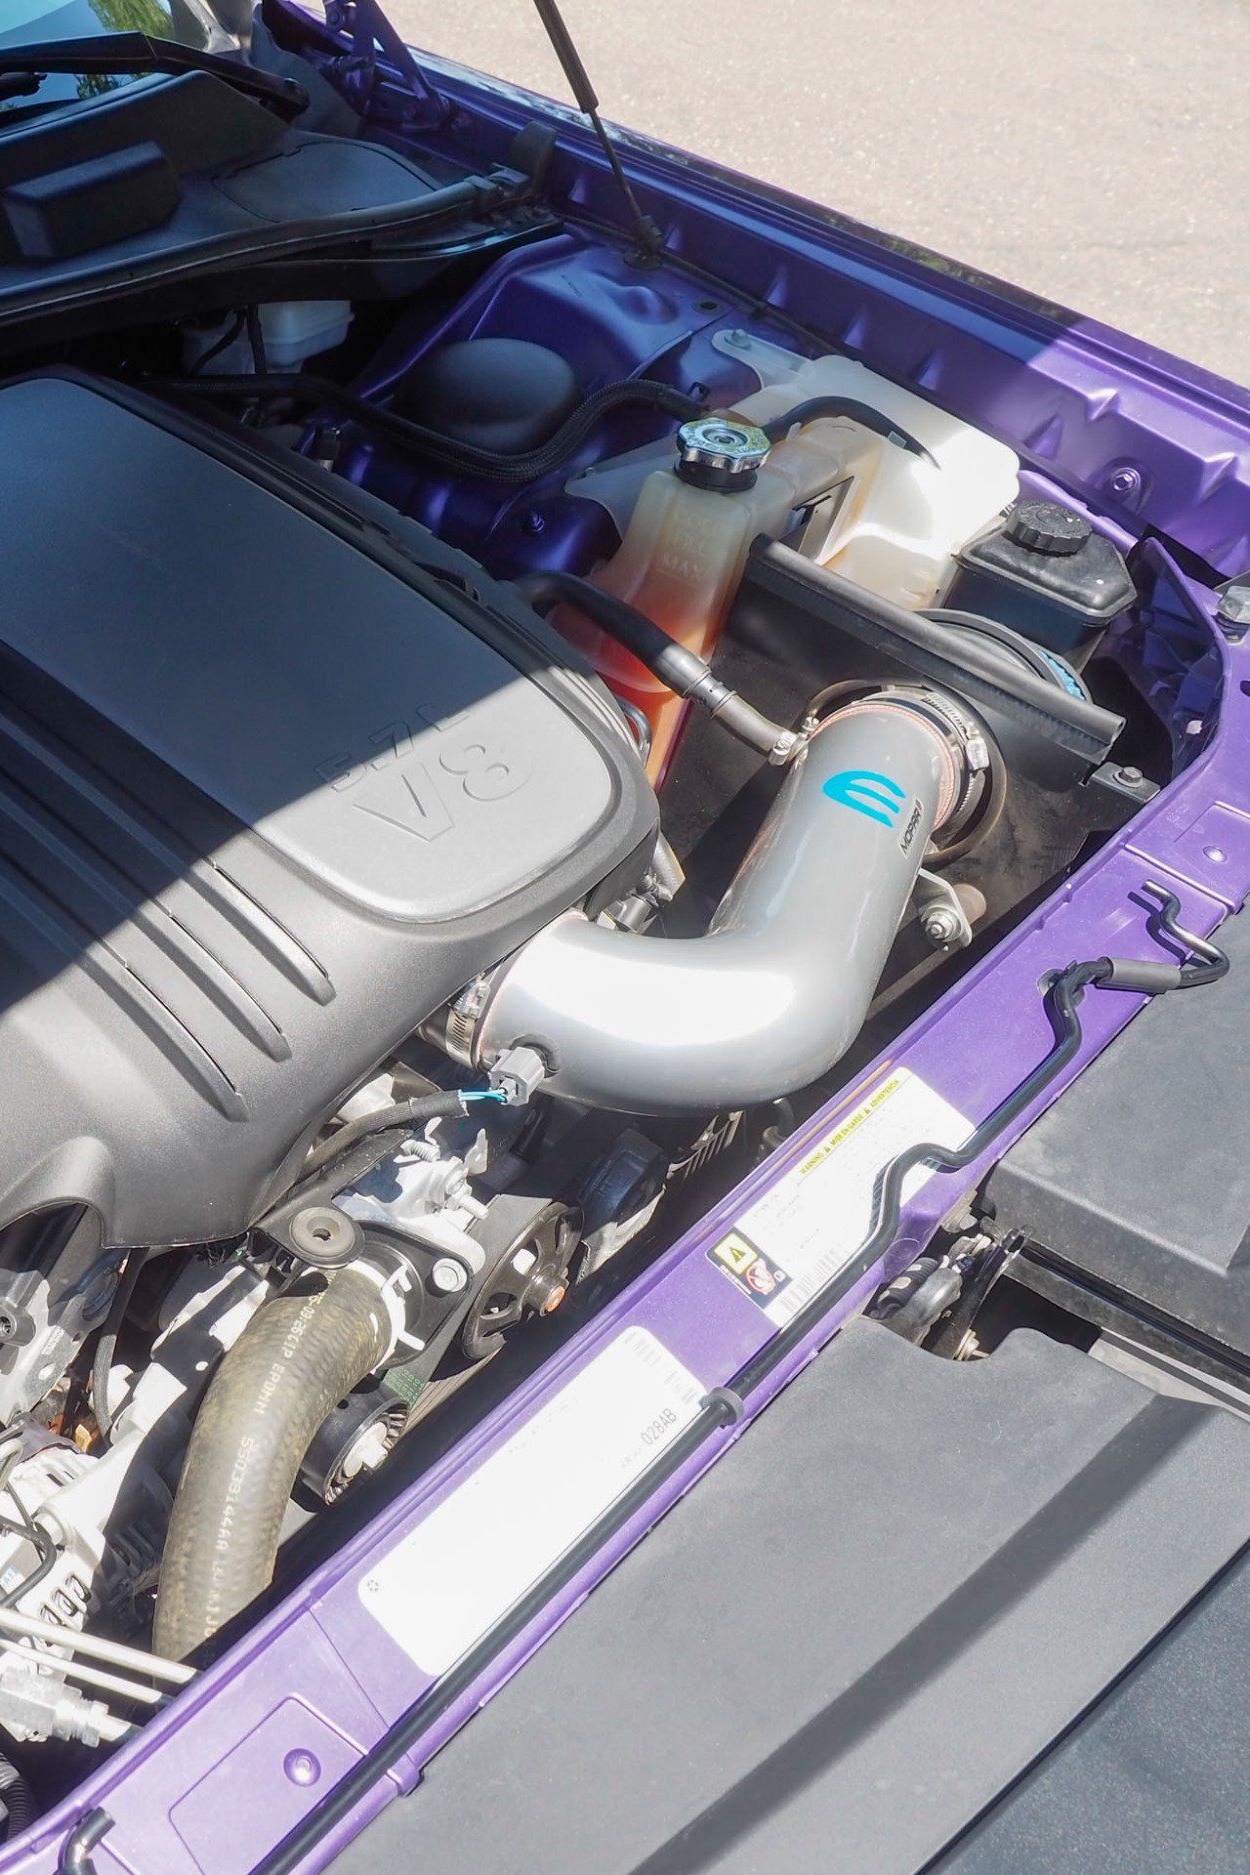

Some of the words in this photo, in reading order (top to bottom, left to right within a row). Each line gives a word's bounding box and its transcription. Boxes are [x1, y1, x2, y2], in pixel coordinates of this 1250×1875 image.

[352, 744, 537, 842] V8
[900, 807, 922, 854] MOPAR
[641, 1407, 677, 1446] 028AB
